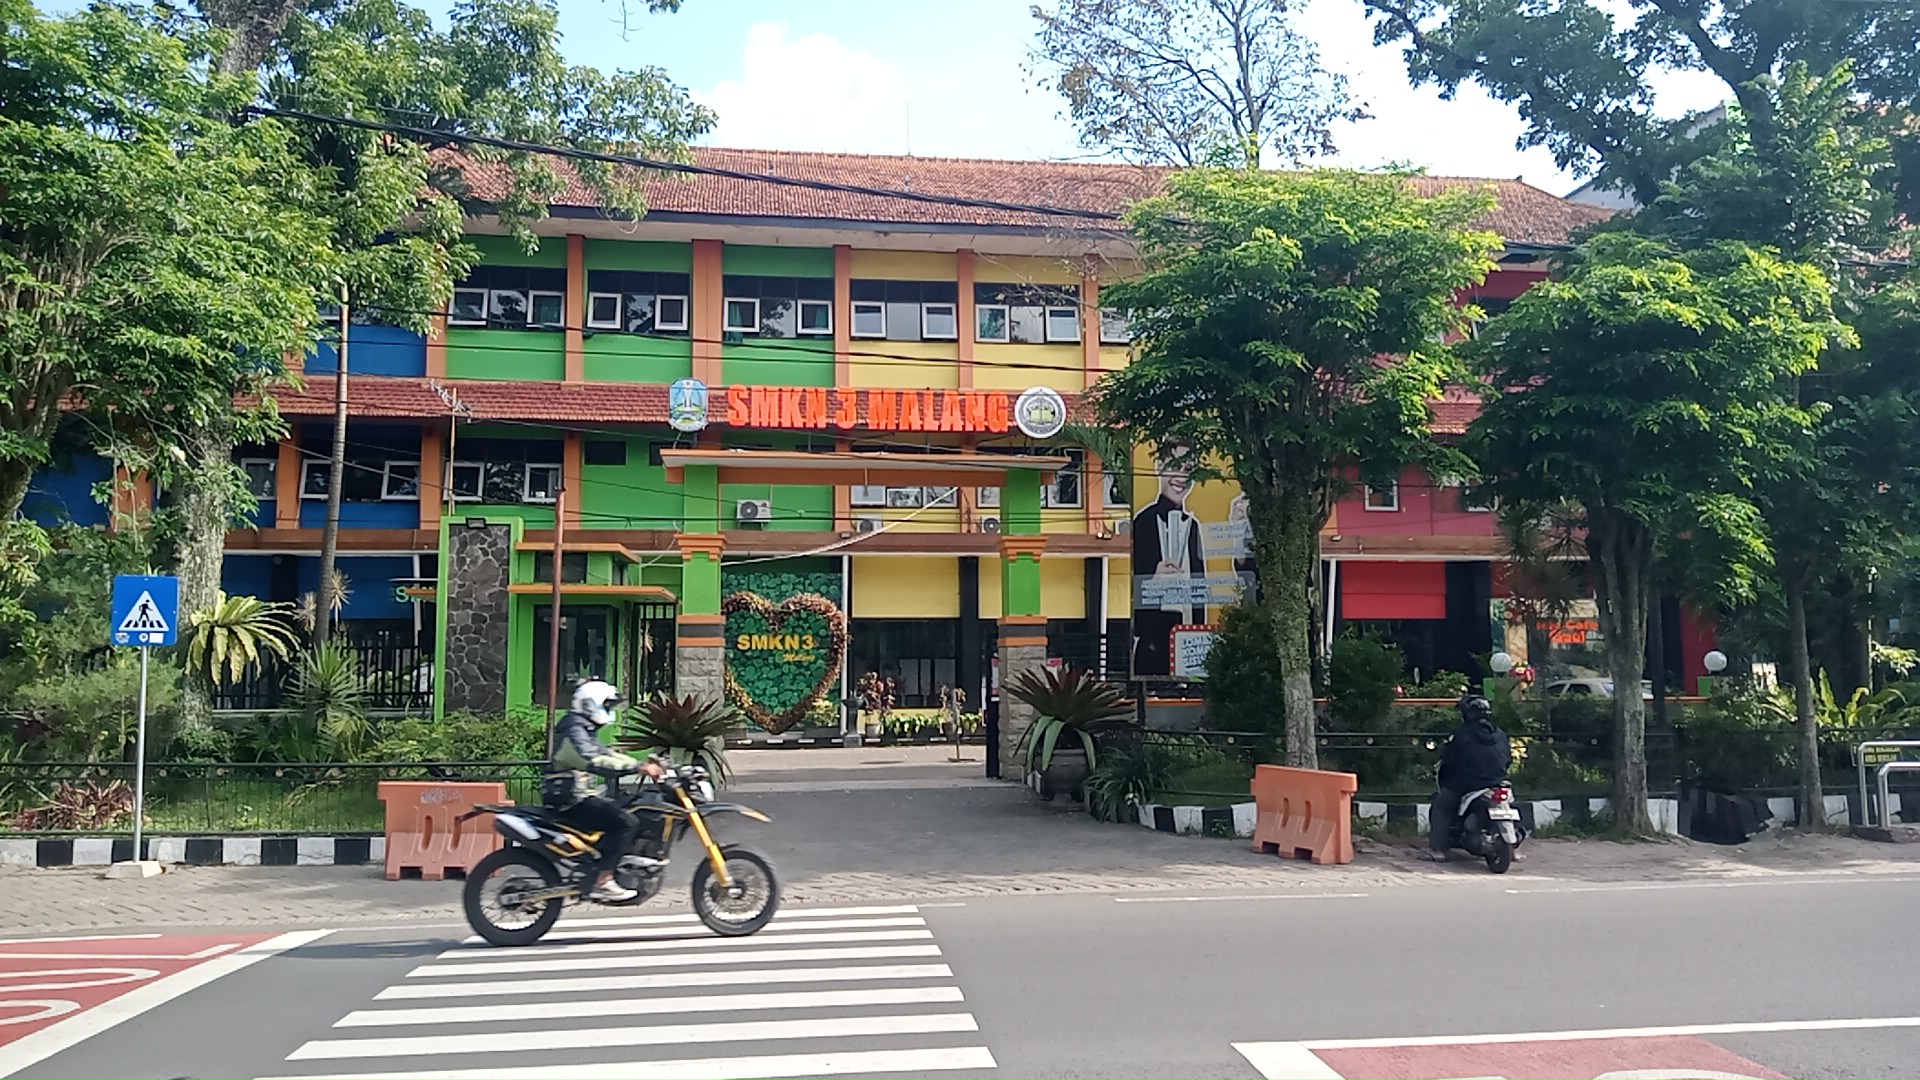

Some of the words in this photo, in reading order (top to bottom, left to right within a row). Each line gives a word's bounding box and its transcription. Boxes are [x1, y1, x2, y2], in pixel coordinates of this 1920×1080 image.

[727, 384, 827, 429] SMKN
[835, 386, 857, 430] 3
[867, 389, 1010, 433] MALANG
